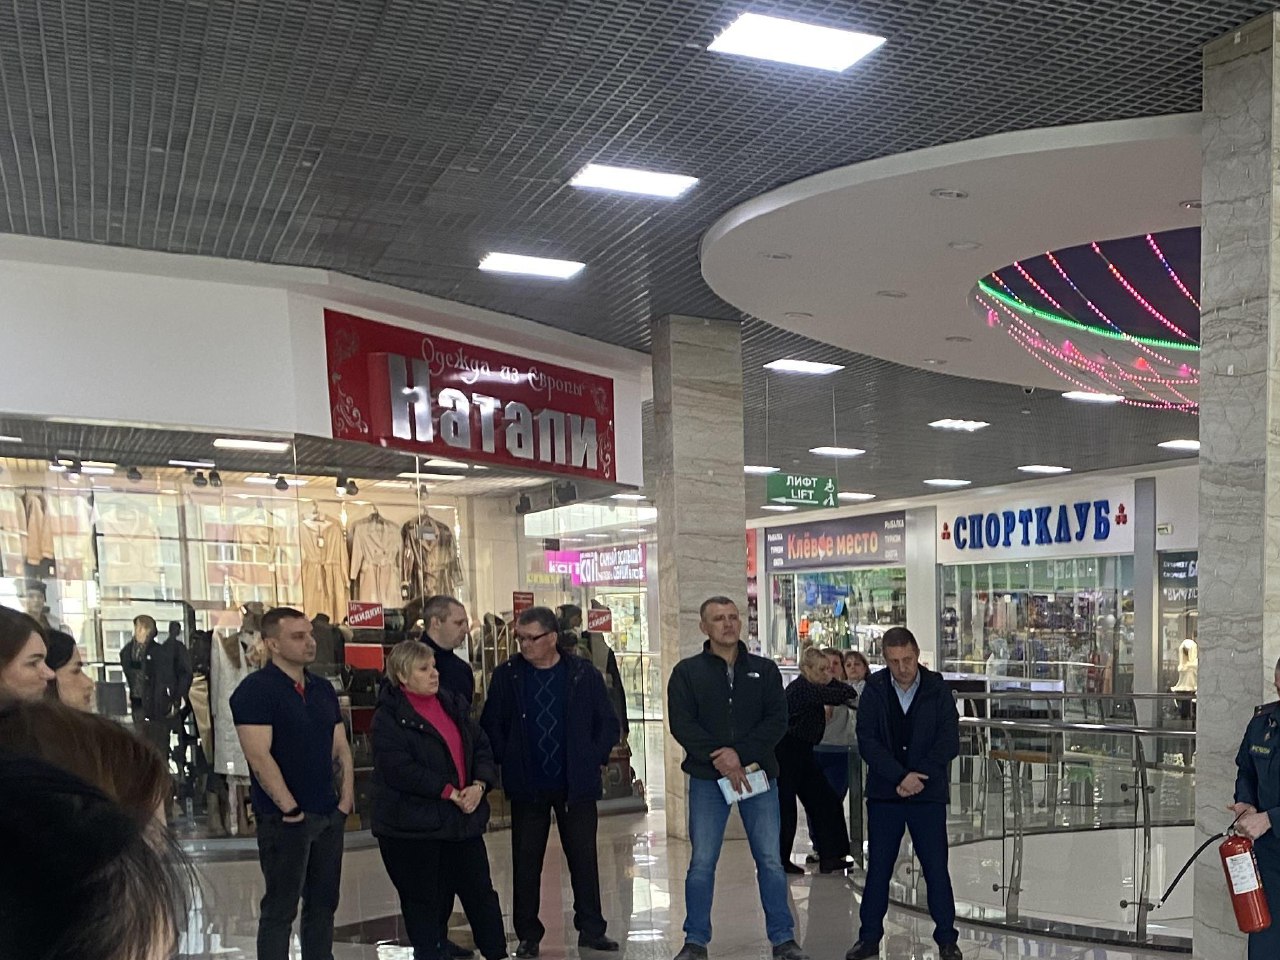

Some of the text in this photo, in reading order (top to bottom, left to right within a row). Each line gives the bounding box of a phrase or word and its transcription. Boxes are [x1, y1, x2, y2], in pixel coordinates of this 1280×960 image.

[421, 338, 490, 385] Одежда
[500, 364, 519, 384] из
[388, 353, 598, 471] Натали
[786, 475, 818, 487] ЛИФТ
[791, 489, 814, 500] LIFT
[953, 500, 1111, 550] СПОРТКЛУБ
[787, 531, 834, 560] Клёвое
[836, 531, 879, 556] место
